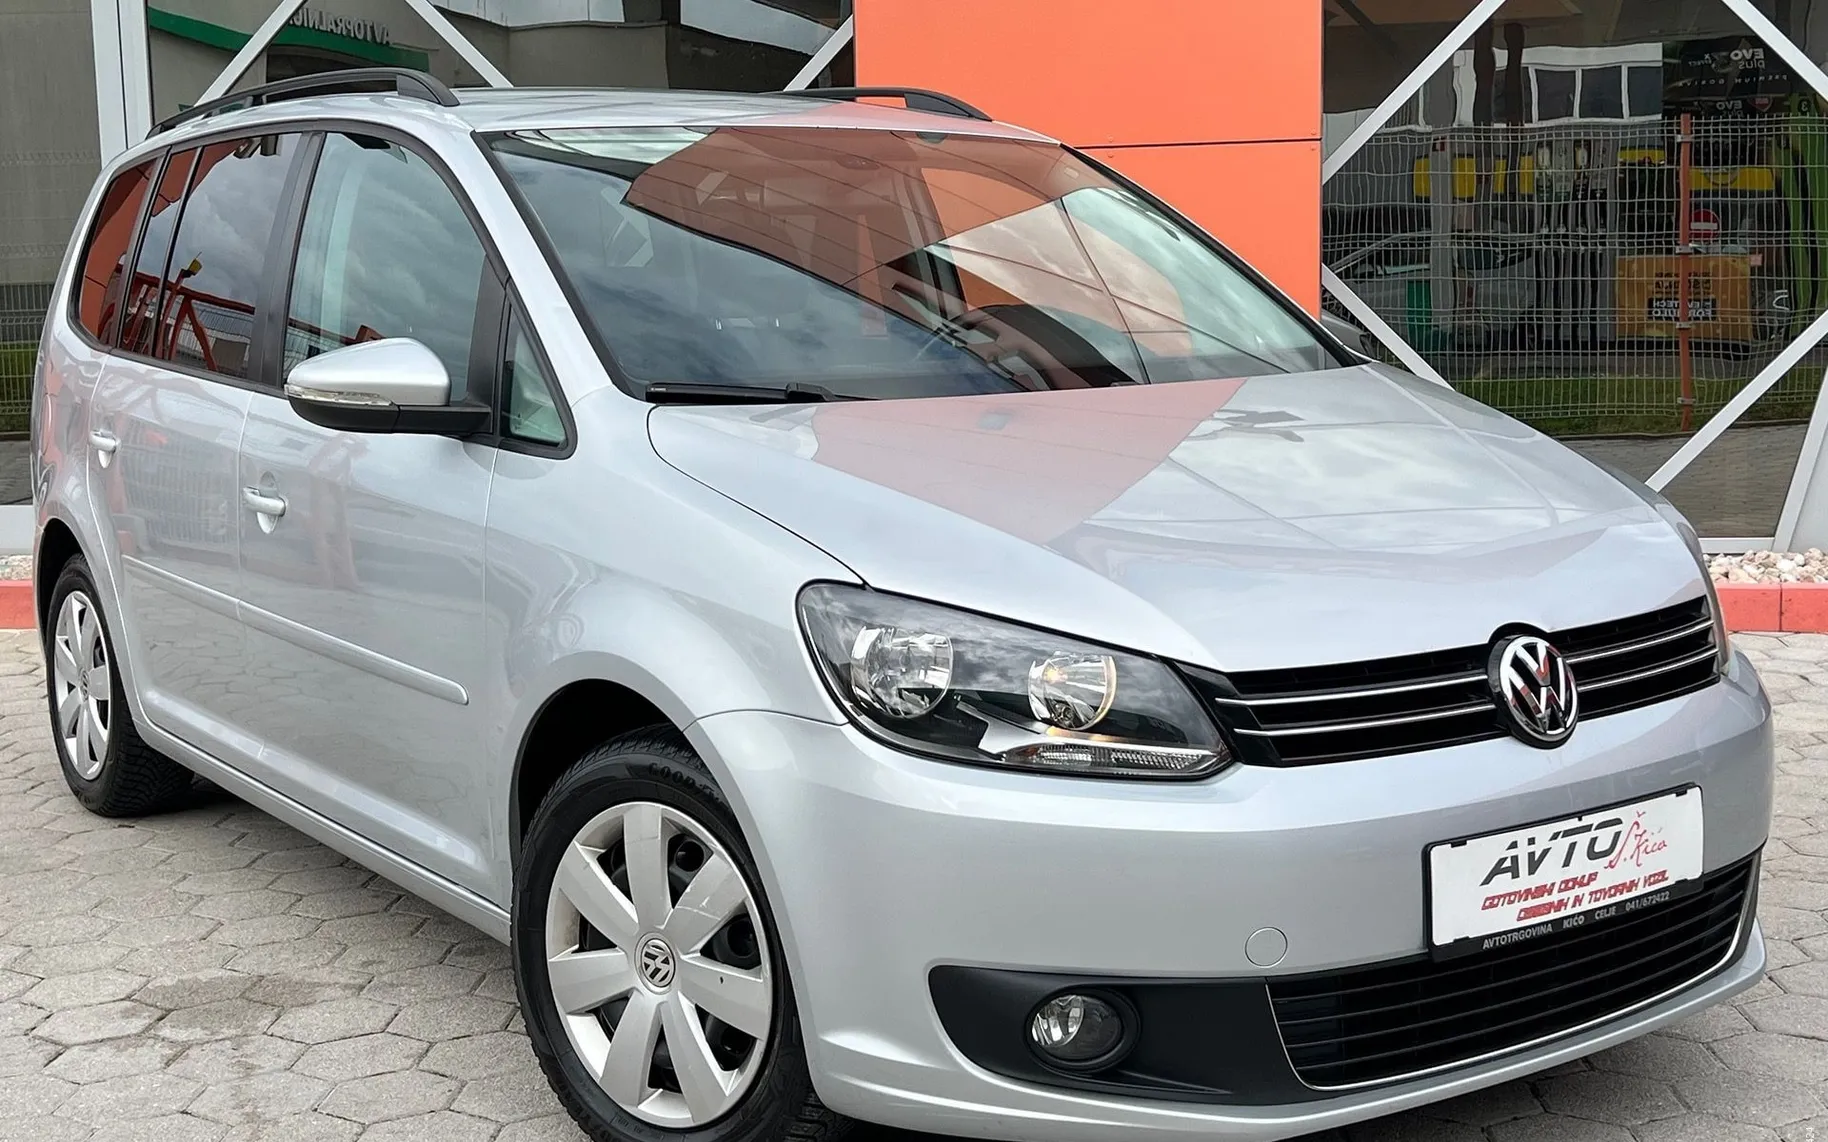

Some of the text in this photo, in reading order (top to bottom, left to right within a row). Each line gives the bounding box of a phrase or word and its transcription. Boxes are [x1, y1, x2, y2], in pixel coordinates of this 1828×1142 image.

[1480, 818, 1623, 887] AVTO
[1482, 890, 1670, 950] AVTOTRGOVINA KIĆO CELJE 041/672422
[1571, 893, 1585, 908] IN
